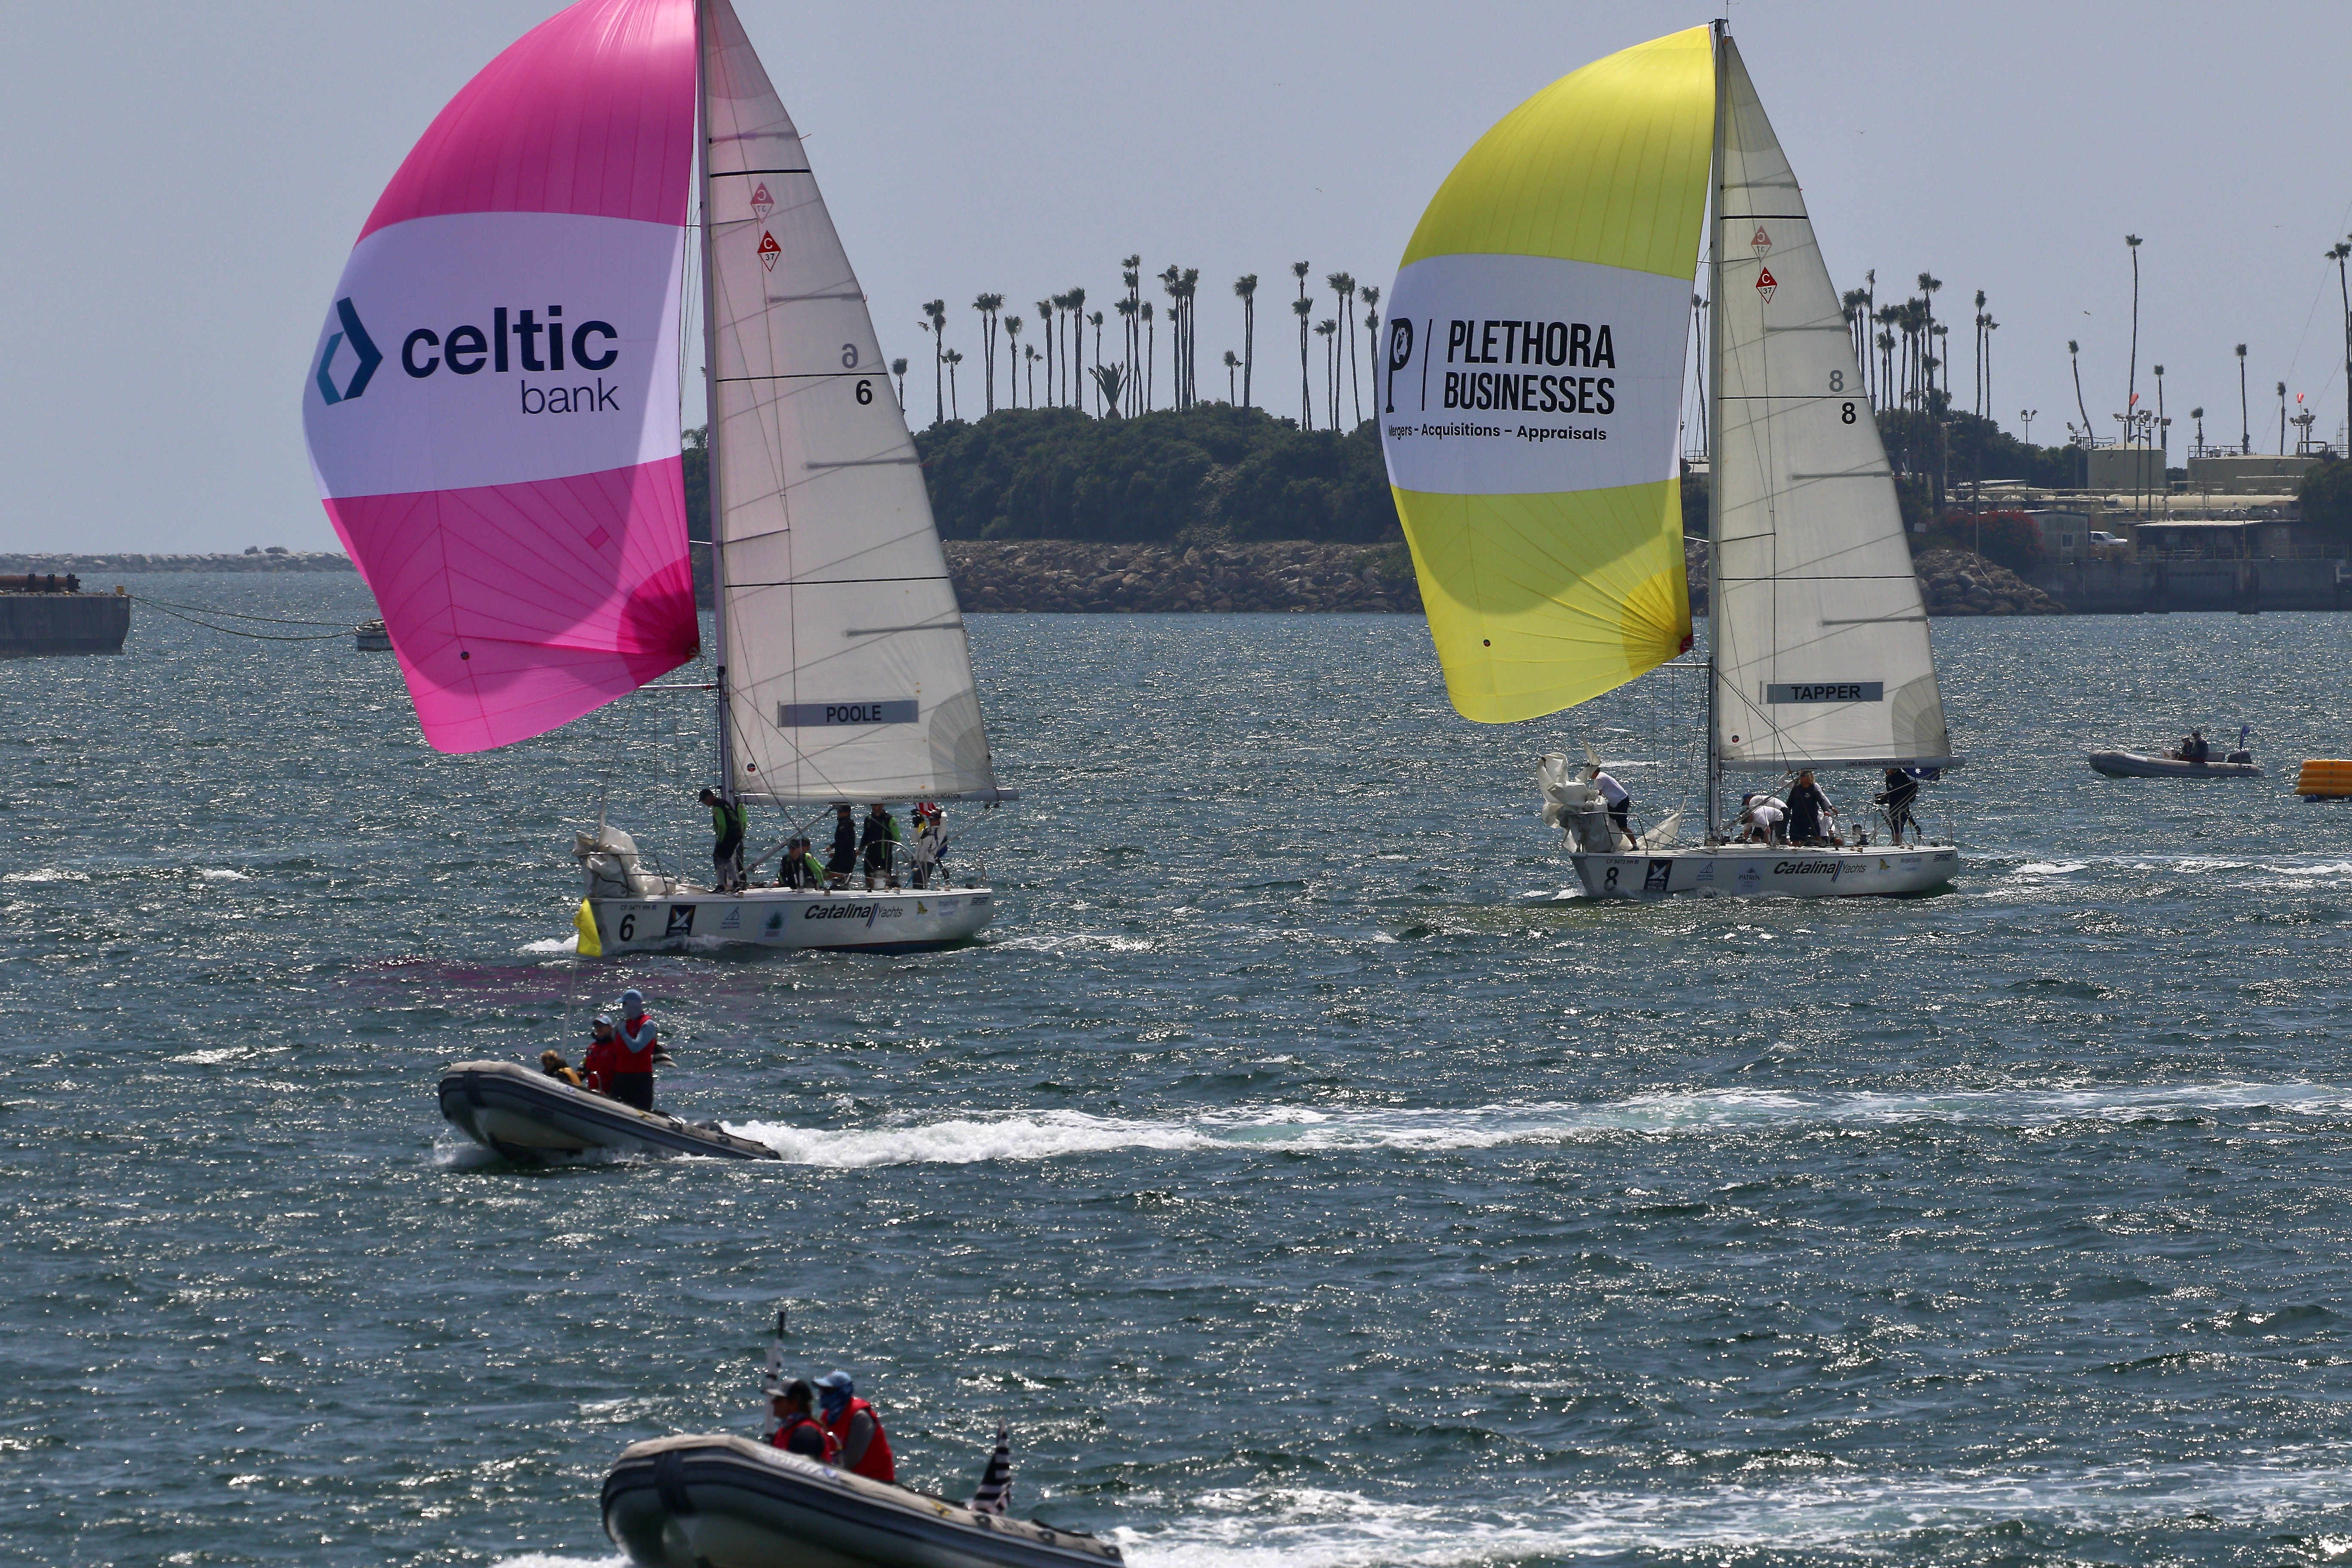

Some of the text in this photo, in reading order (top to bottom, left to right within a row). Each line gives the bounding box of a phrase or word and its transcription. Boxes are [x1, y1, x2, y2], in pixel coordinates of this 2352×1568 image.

[763, 238, 772, 249] C
[1762, 273, 1770, 284] C
[401, 305, 619, 378] celtic
[1447, 320, 1615, 369] PLETHORA
[521, 378, 620, 414] bank
[856, 380, 873, 405] 6
[1443, 372, 1615, 415] BUSINESSES
[1841, 402, 1856, 425] 8
[1421, 423, 1501, 440] Acquisitions
[1516, 426, 1607, 442] Appraisals
[1791, 685, 1861, 700] TAPPER
[826, 705, 882, 723] POOLE
[1604, 867, 1619, 891] 8
[1773, 861, 1866, 874] Catalina Yachts
[805, 903, 903, 919] Catalina Yachts
[619, 913, 636, 942] 6
